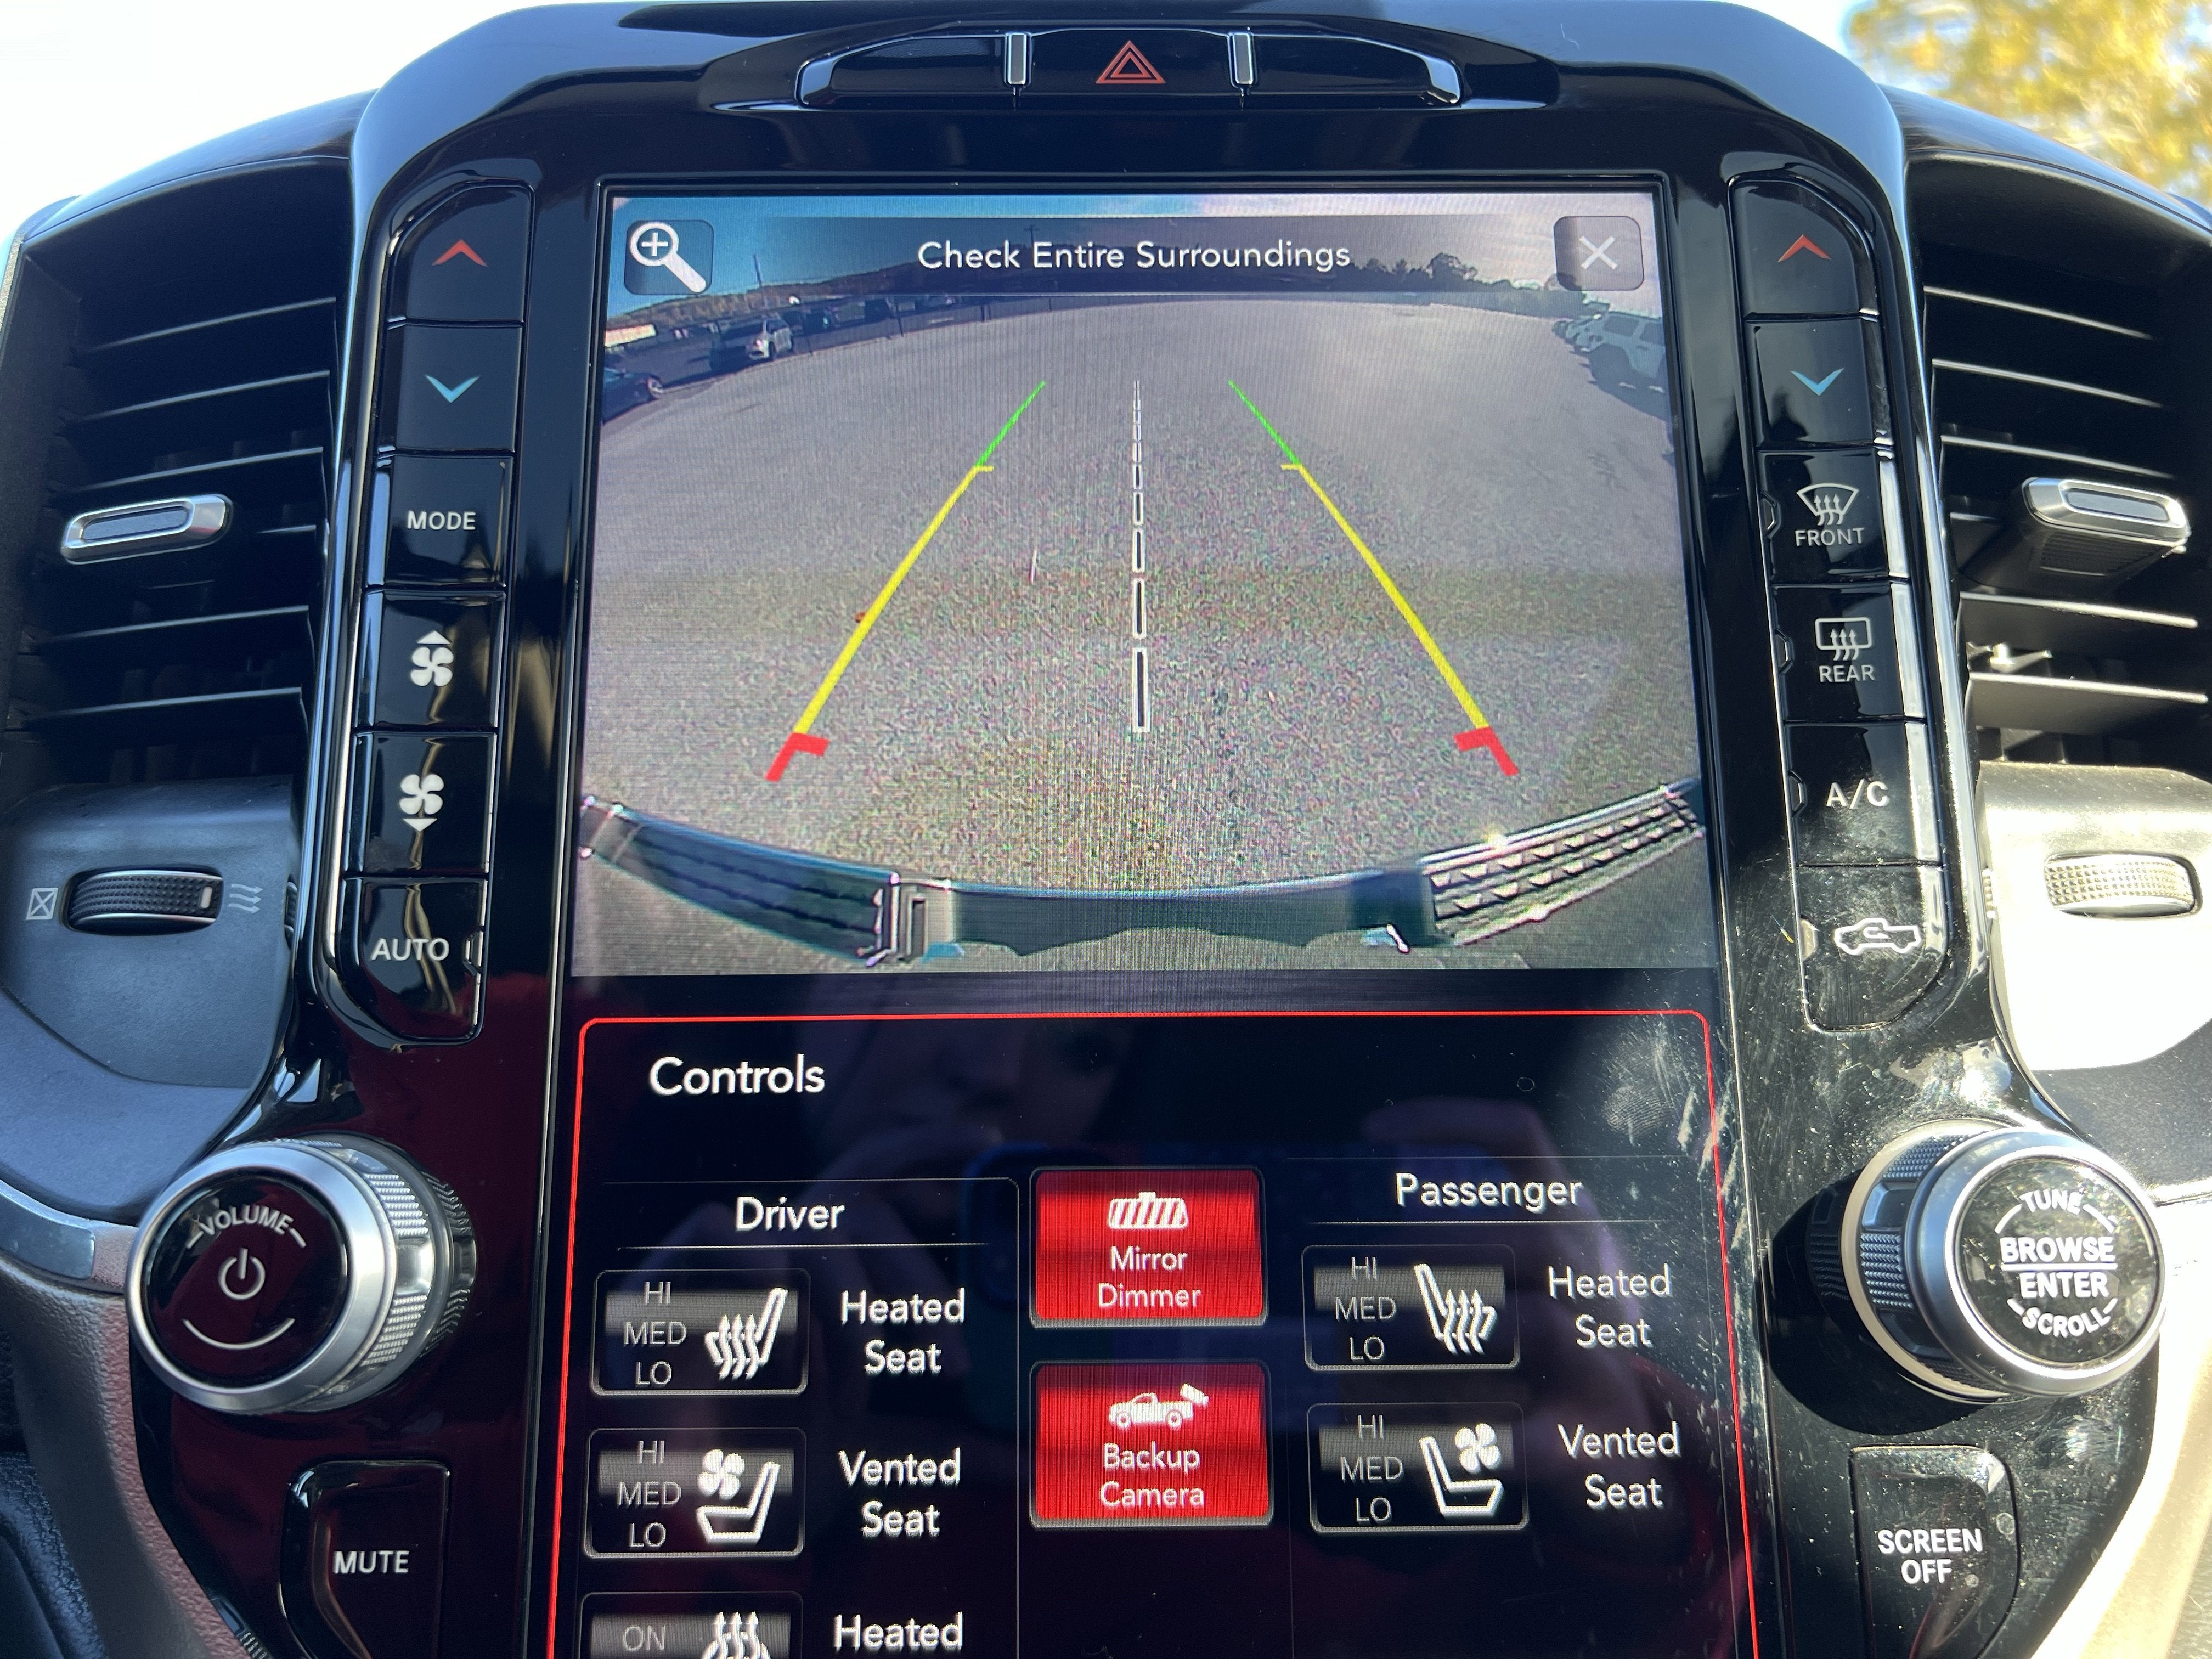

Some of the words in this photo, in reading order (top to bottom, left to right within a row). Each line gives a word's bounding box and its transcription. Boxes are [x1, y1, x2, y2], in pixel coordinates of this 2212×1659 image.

[917, 240, 1020, 270] Check
[1032, 240, 1124, 270] Entire
[1136, 240, 1351, 273] Surroundings
[406, 510, 477, 531] MODE
[1795, 526, 1866, 548] FRONT
[1818, 664, 1876, 683] REAR
[1826, 780, 1890, 808] A/C
[371, 937, 450, 961] AUTO
[649, 1055, 826, 1097] Controls
[1395, 1172, 1583, 1214] Passenger
[2019, 1189, 2085, 1215] TUNE
[199, 1205, 294, 1235] VOLUME
[735, 1198, 845, 1232] Driver
[1110, 1246, 1187, 1272] Mirror
[2001, 1236, 2114, 1263] BROWSE
[1351, 1256, 1378, 1280] HI
[644, 1282, 672, 1305] HI
[1548, 1263, 1672, 1301] Heated
[2019, 1273, 2109, 1300] ENTER
[840, 1288, 965, 1324] Heated
[1098, 1284, 1201, 1309] Dimmer
[1335, 1296, 1397, 1321] MED
[623, 1322, 687, 1346] MED
[1576, 1316, 1652, 1350] Seat
[2021, 1306, 2112, 1339] SCROLL
[865, 1341, 941, 1375] Seat
[1350, 1336, 1385, 1362] LO
[635, 1362, 672, 1386] LO
[1357, 1415, 1384, 1441] HI
[1558, 1422, 1681, 1459] Vented
[637, 1440, 665, 1464] HI
[1102, 1443, 1200, 1473] Backup
[839, 1448, 961, 1486] Vented
[1341, 1457, 1404, 1483] MED
[617, 1482, 682, 1506] MED
[1100, 1482, 1204, 1509] Camera
[1585, 1475, 1664, 1510] Seat
[862, 1501, 939, 1537] Seat
[1355, 1497, 1392, 1523] LO
[628, 1523, 667, 1548] LO
[1878, 1527, 1983, 1555] SCREEN
[333, 1550, 409, 1574] MUTE
[1900, 1559, 1953, 1584] OFF
[622, 1626, 665, 1651] ON
[833, 1613, 963, 1650] Heated
